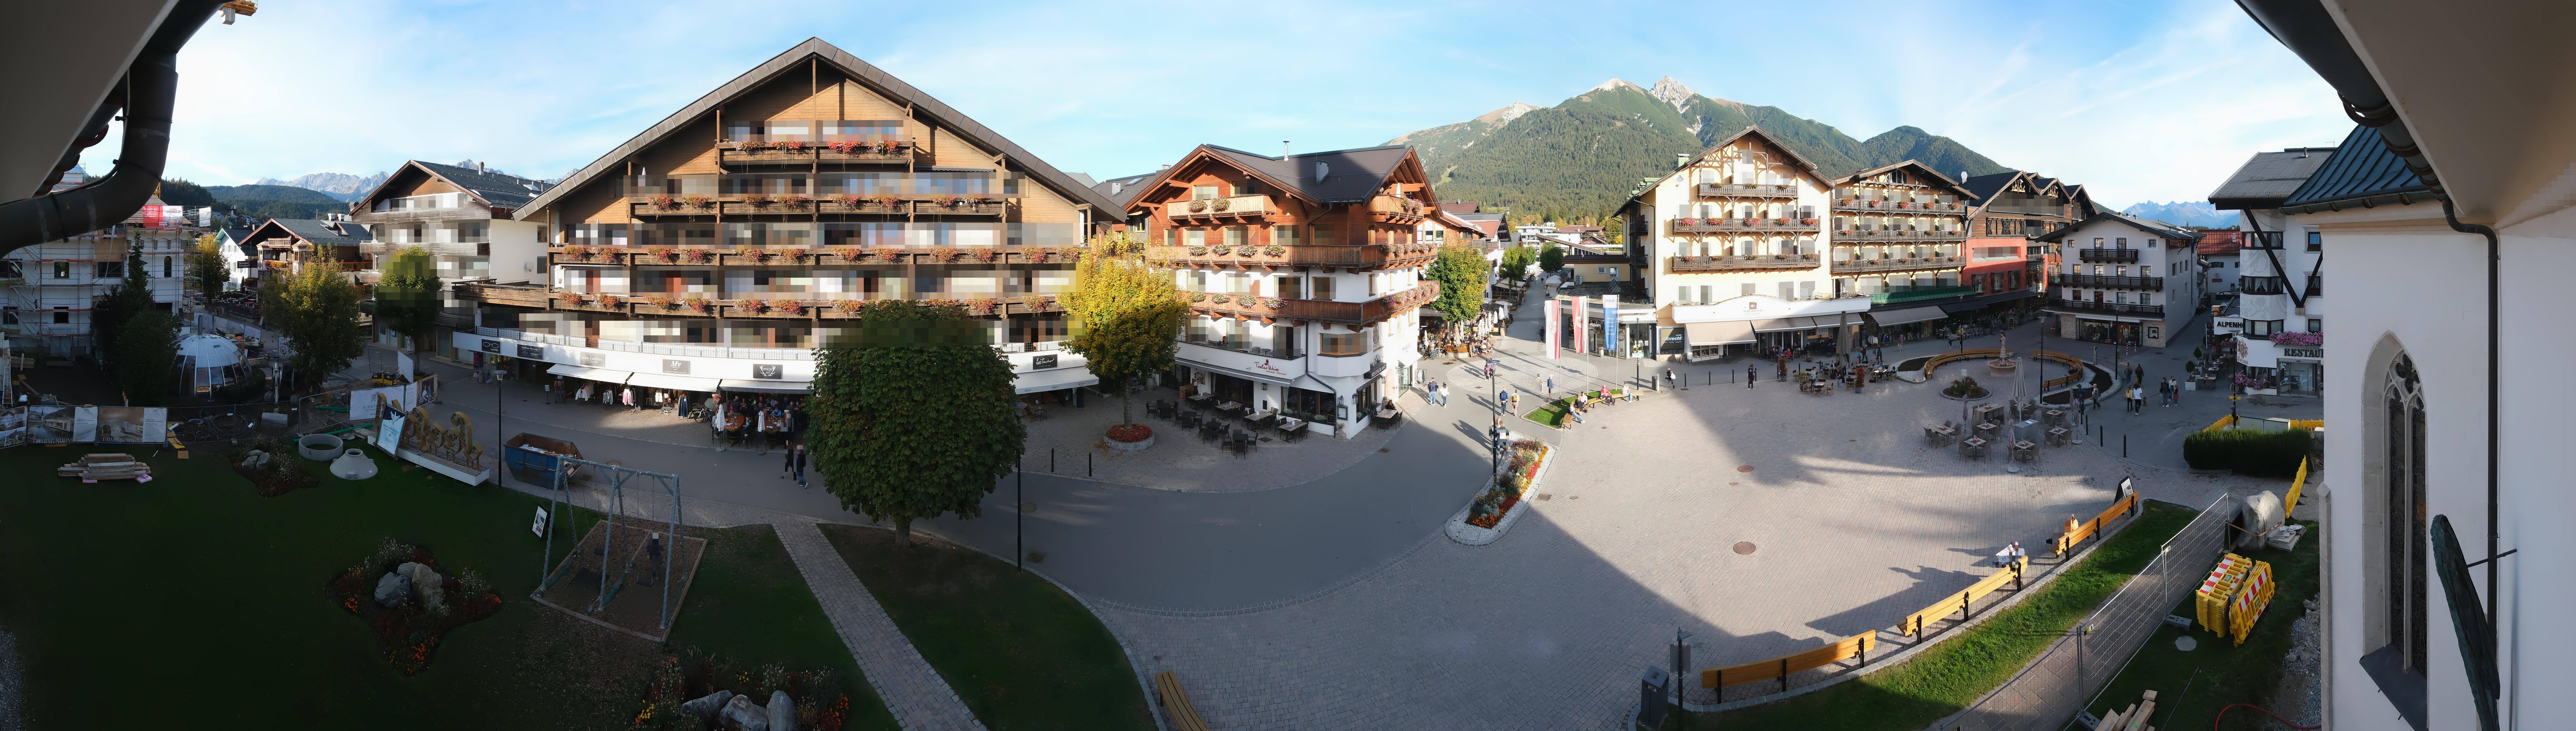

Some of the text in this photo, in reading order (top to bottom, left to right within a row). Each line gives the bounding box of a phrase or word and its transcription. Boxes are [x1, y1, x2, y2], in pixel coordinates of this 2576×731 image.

[670, 361, 681, 370] My
[1372, 364, 1386, 377] RESTAURANT
[383, 424, 395, 432] DEAFLYMPICS
